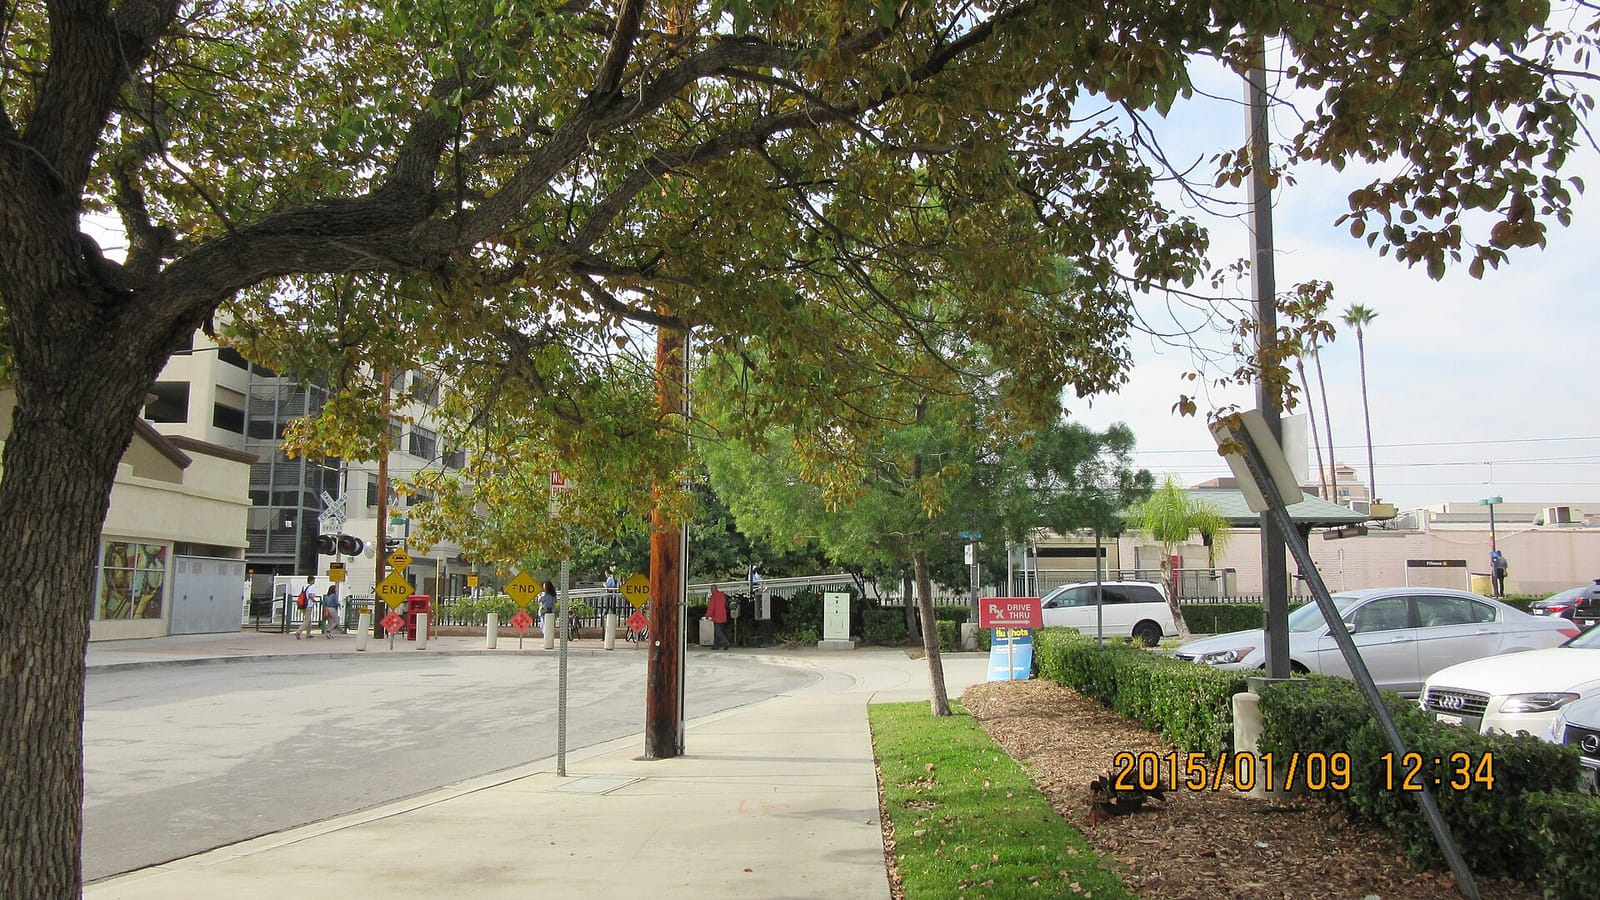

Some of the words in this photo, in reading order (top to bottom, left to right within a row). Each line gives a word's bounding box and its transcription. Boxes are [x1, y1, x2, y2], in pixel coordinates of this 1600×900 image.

[382, 584, 406, 595] END
[626, 585, 650, 595] END
[1009, 611, 1030, 619] THRU
